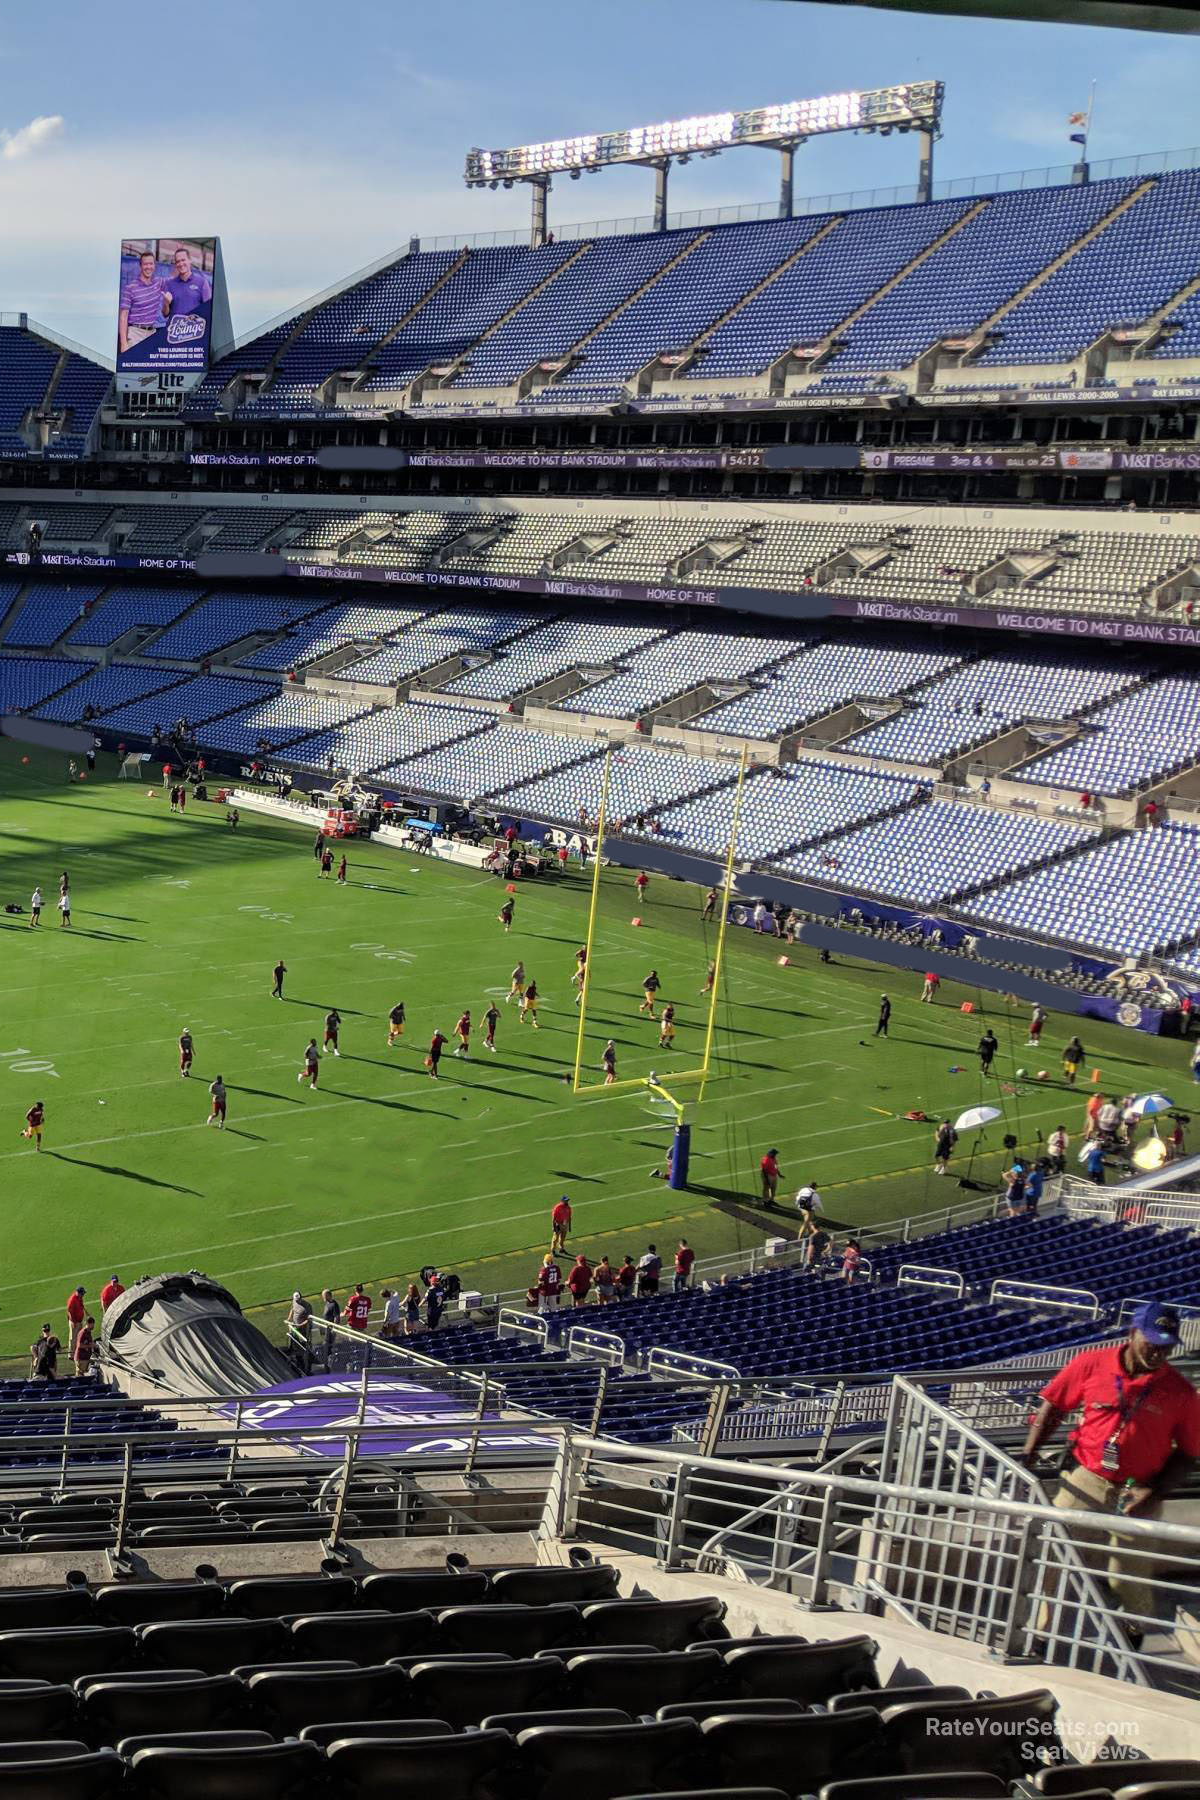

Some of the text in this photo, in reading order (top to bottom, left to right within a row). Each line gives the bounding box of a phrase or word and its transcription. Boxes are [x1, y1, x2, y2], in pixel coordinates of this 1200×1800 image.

[158, 373, 184, 390] Lite
[1027, 392, 1052, 401] JAMAL
[1053, 391, 1076, 400] LEWIS
[1078, 390, 1119, 400] 2000-2006
[1152, 389, 1168, 398] RAY
[1170, 388, 1193, 398] LEWIS
[808, 398, 831, 407] OGDEN
[190, 455, 260, 465] M&T Bank Stadium
[268, 456, 319, 465] HOME OF TH
[409, 456, 474, 466] M&T Bank Stadium
[484, 456, 626, 465] WELCOME TO M&T BANK STADIUM
[730, 456, 760, 466] 54:12
[894, 456, 935, 466] PREGAME
[985, 456, 993, 466] 4
[1040, 455, 1056, 466] 25
[1121, 454, 1153, 467] M&T
[1154, 455, 1186, 467] Bank
[42, 555, 116, 567] M&T Bank Stadium
[139, 559, 196, 569] HOME OF THE
[299, 566, 362, 579] M&T Bank Stadium
[385, 571, 520, 589] WELCOME TO M&T BANK STADIUM
[544, 582, 622, 598] M&T Bank Stadium
[647, 588, 715, 603] HOME OF THE
[856, 602, 958, 624] M&T Bank Stadium
[996, 613, 1065, 631] WELCOME
[1068, 618, 1089, 633] TO
[1091, 620, 1122, 636] M&T
[1125, 623, 1164, 640] BANK
[549, 1273, 557, 1283] 21
[356, 1306, 369, 1318] 21
